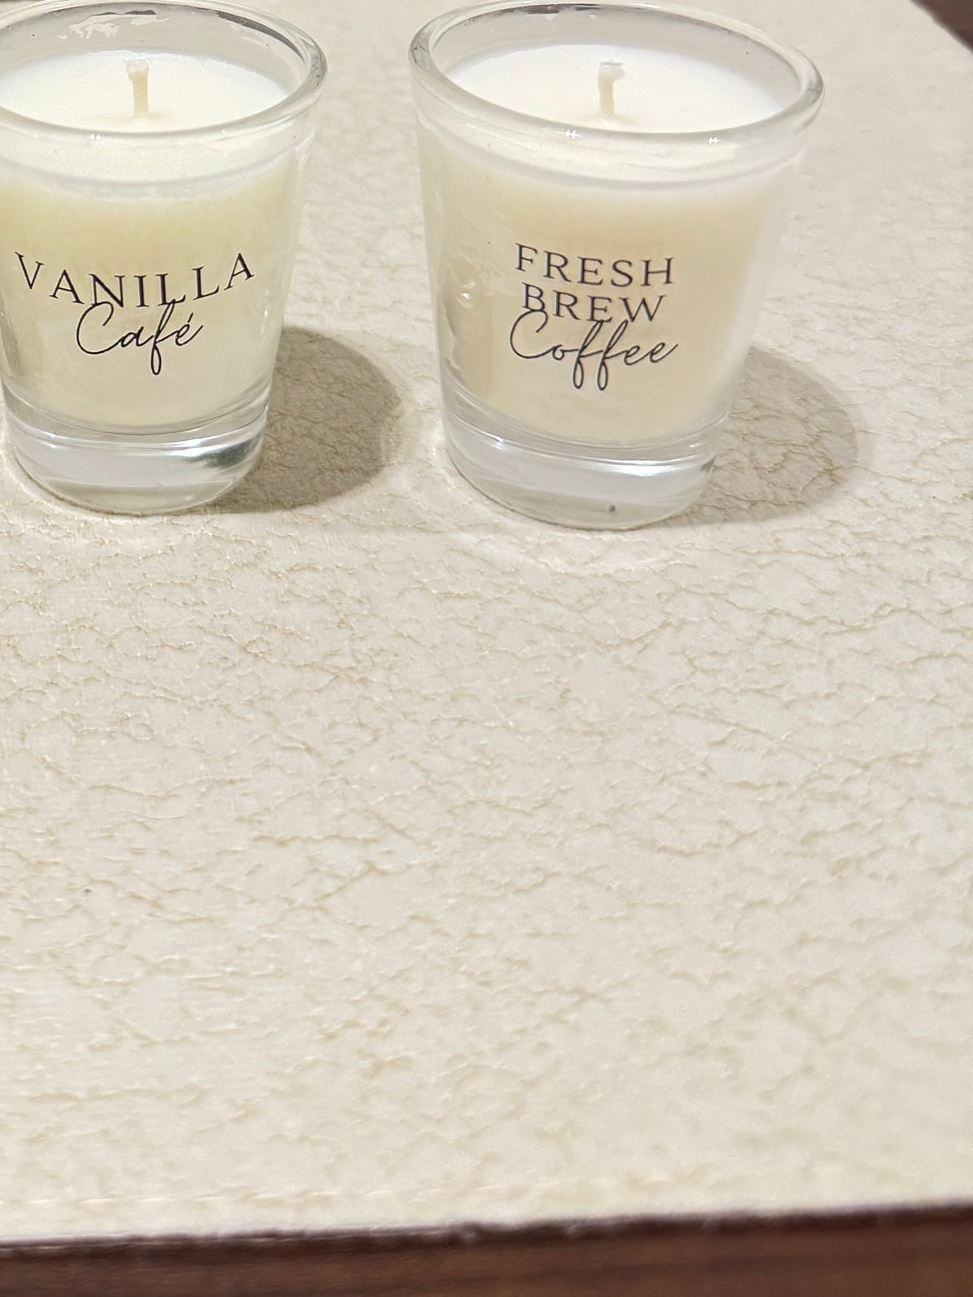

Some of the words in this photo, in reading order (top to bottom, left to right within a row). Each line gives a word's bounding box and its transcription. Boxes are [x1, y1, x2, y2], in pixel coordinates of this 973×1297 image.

[14, 251, 255, 308] VANILLA
[514, 242, 676, 286] FRESH
[521, 281, 667, 324] BREW
[75, 299, 205, 376] Café
[508, 308, 679, 391] Coffee
